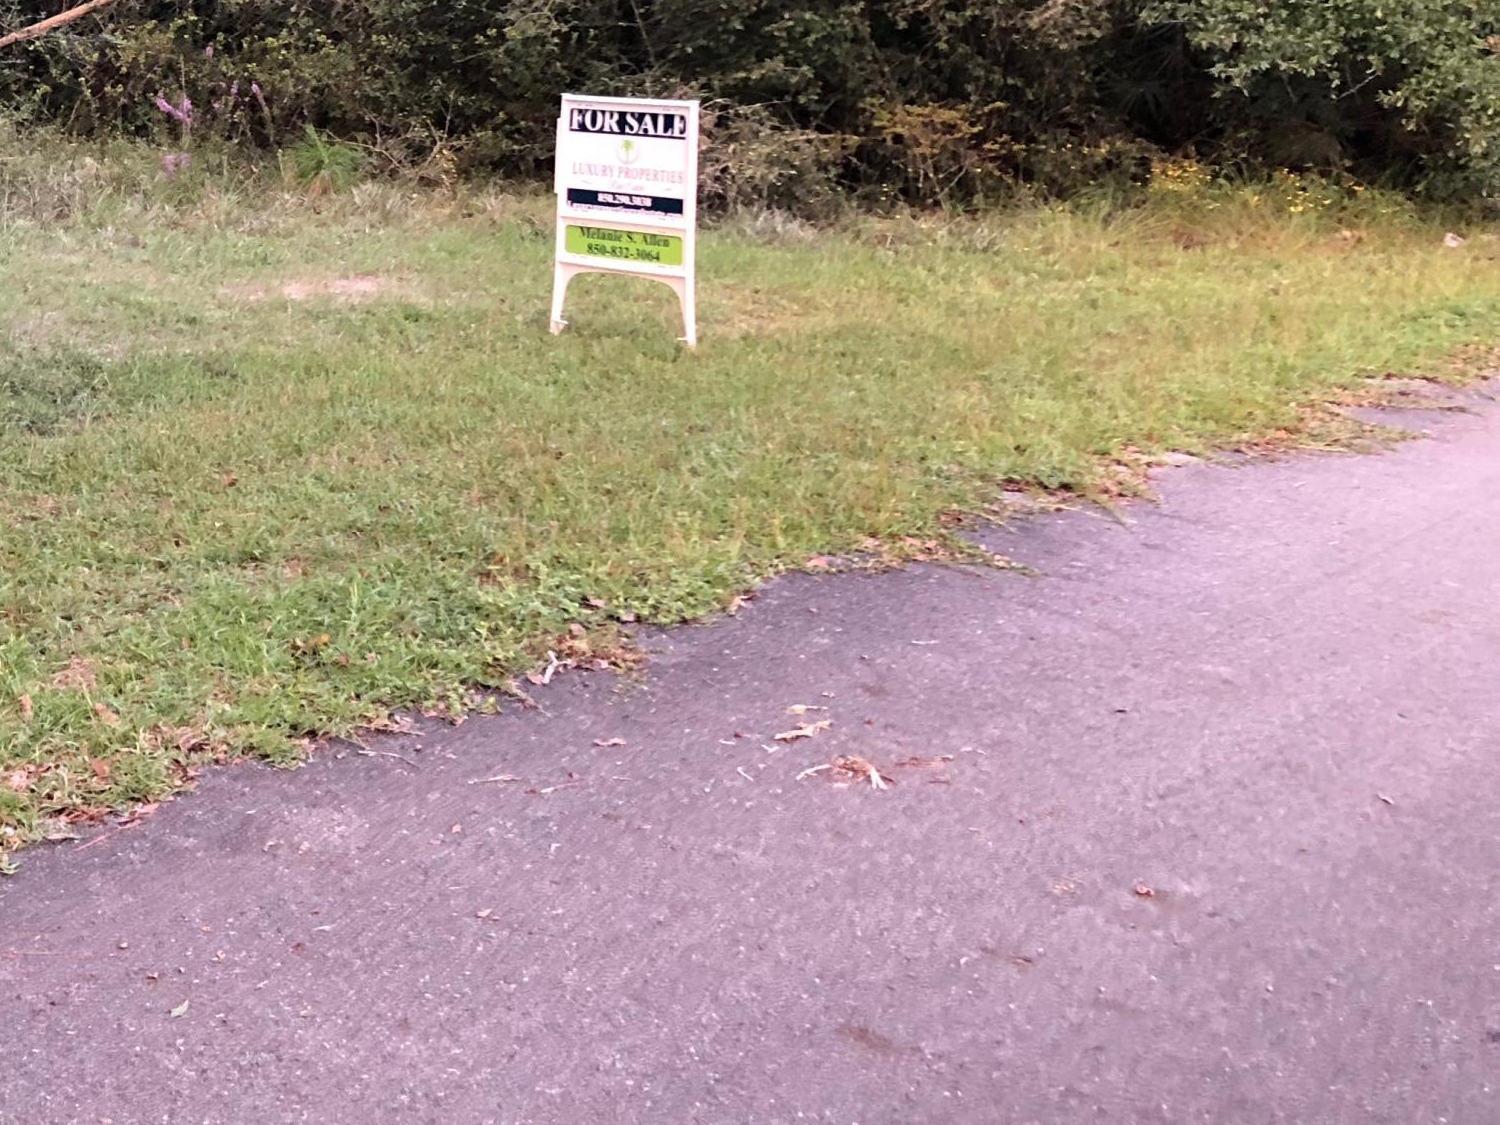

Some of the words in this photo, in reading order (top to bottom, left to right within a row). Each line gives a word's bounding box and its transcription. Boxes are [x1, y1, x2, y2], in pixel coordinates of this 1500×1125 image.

[571, 108, 620, 133] FOR
[624, 112, 687, 137] SALE
[572, 162, 614, 178] LUXURY
[617, 166, 684, 184] PROPERTIES
[580, 226, 623, 242] Melanie
[642, 234, 670, 248] Allen
[587, 242, 661, 262] 850-832-3064
